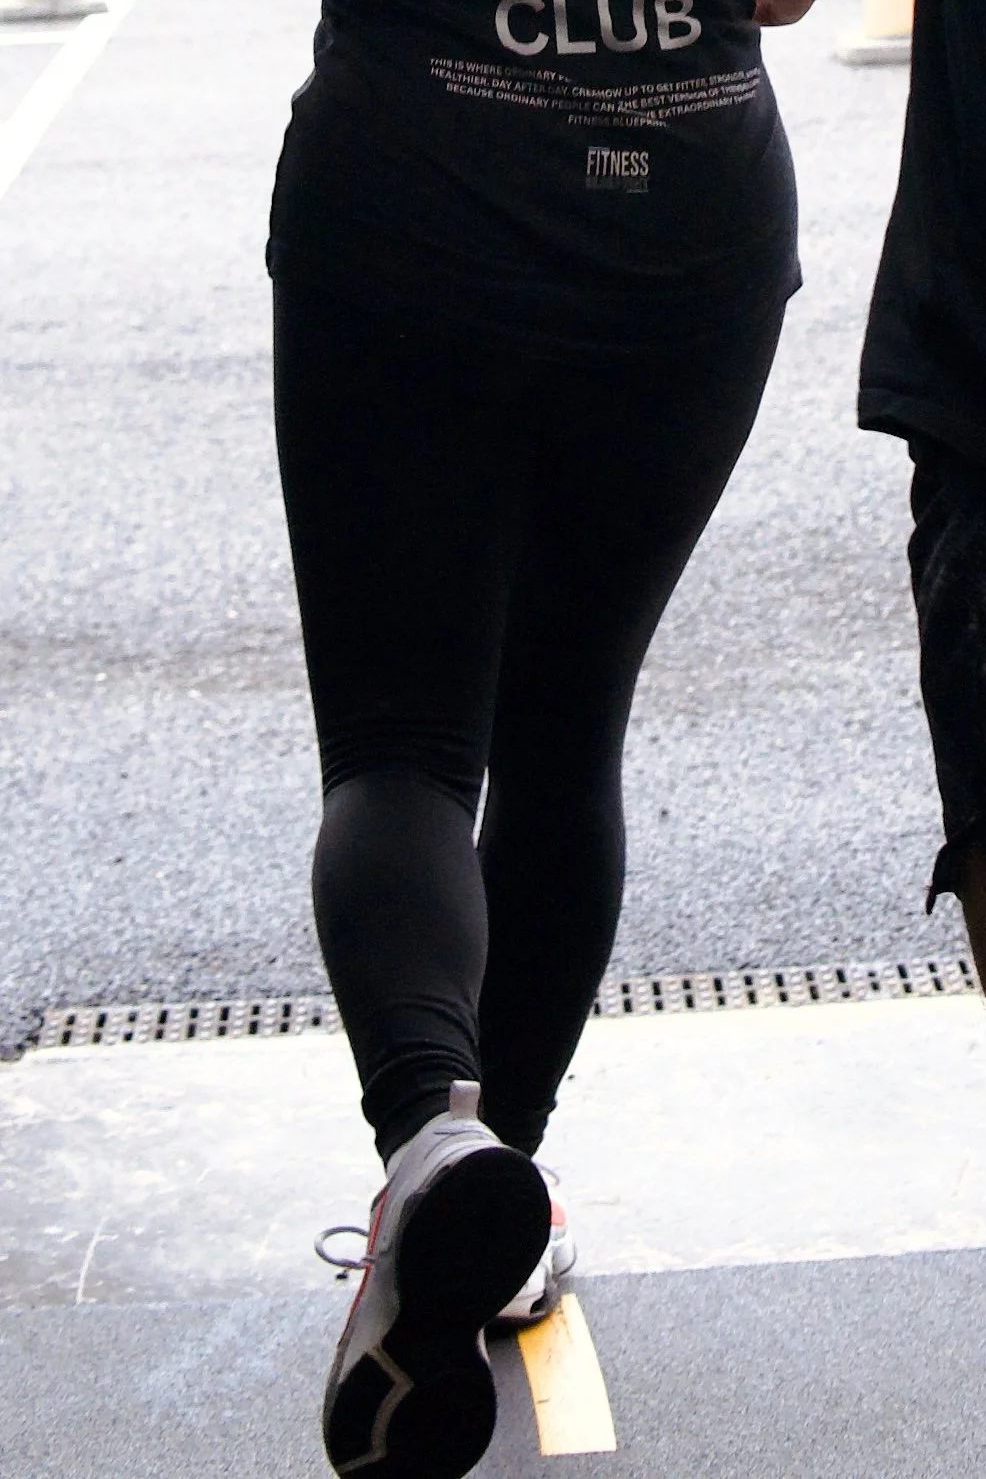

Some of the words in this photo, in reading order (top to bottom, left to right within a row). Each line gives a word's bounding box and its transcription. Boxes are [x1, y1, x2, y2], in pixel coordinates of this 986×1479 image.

[430, 58, 453, 68] THIS
[454, 60, 464, 71] IS
[466, 62, 502, 76] WHERE
[624, 85, 639, 97] UP
[641, 84, 655, 95] TO
[446, 82, 494, 99] BECAUSE
[495, 90, 550, 108] ORDINARY
[592, 101, 615, 113] CAN
[640, 95, 666, 108] BEST
[586, 149, 650, 176] FITNESS
